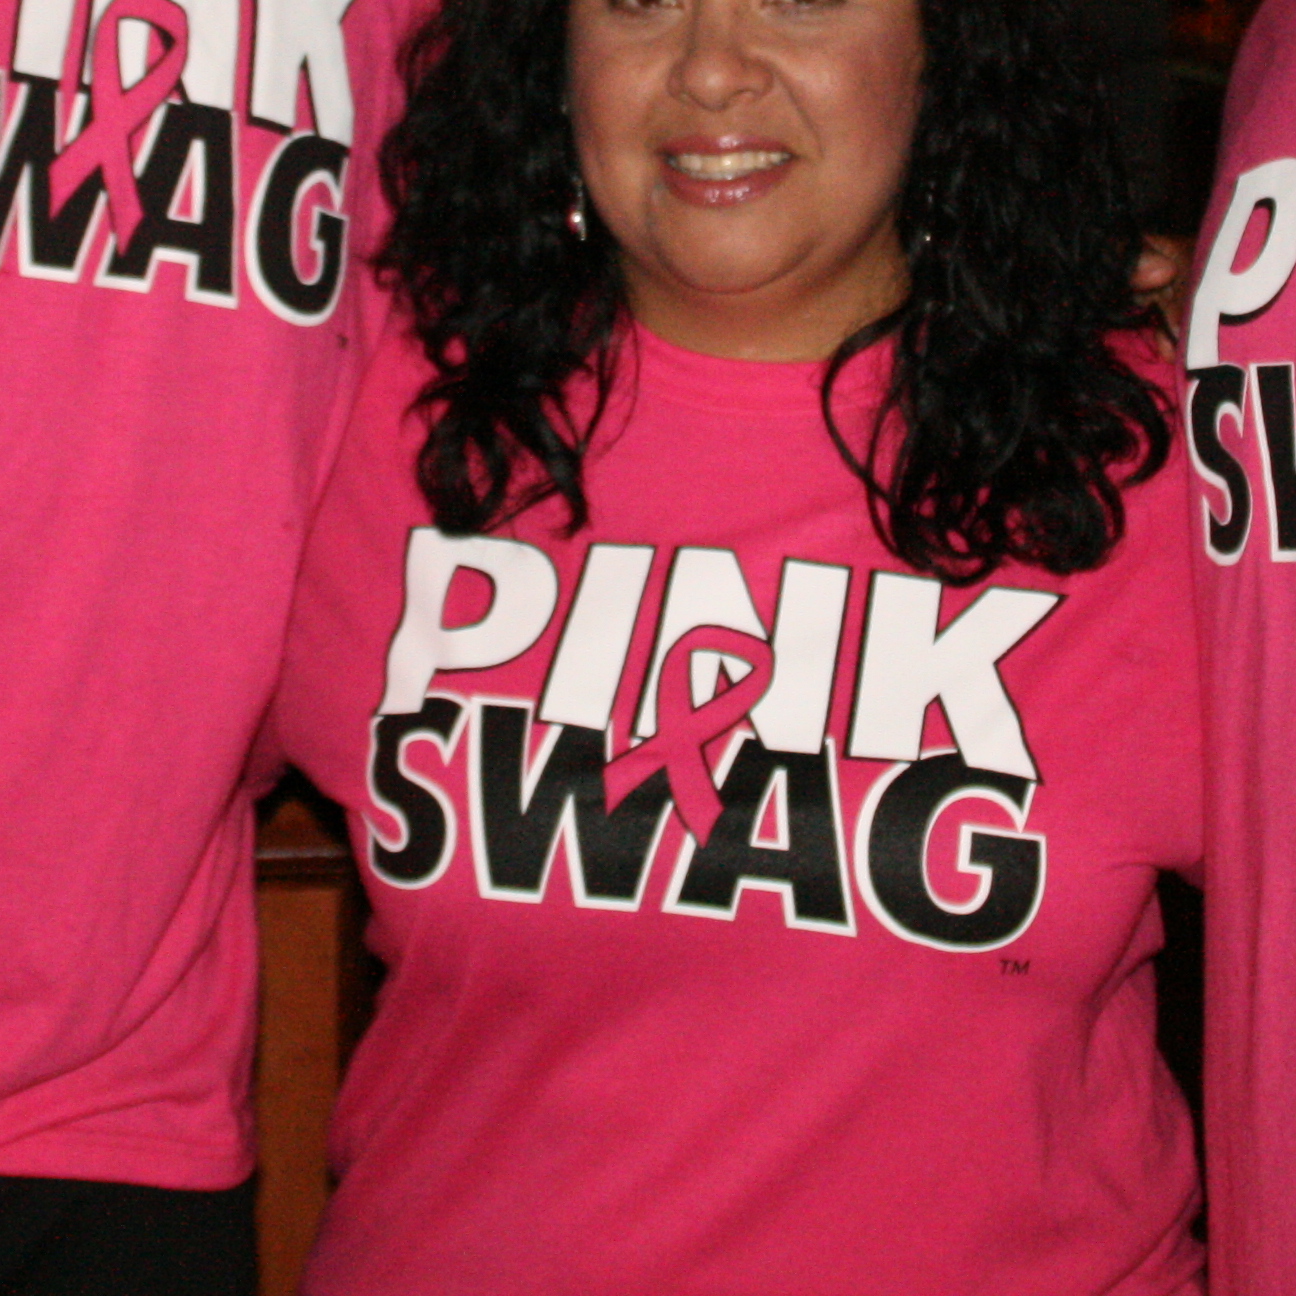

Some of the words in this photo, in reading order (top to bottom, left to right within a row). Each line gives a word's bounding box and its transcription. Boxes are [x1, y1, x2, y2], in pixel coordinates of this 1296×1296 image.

[373, 526, 1066, 784] PINK
[364, 690, 1047, 953] SWAG
[999, 958, 1031, 976] TM
